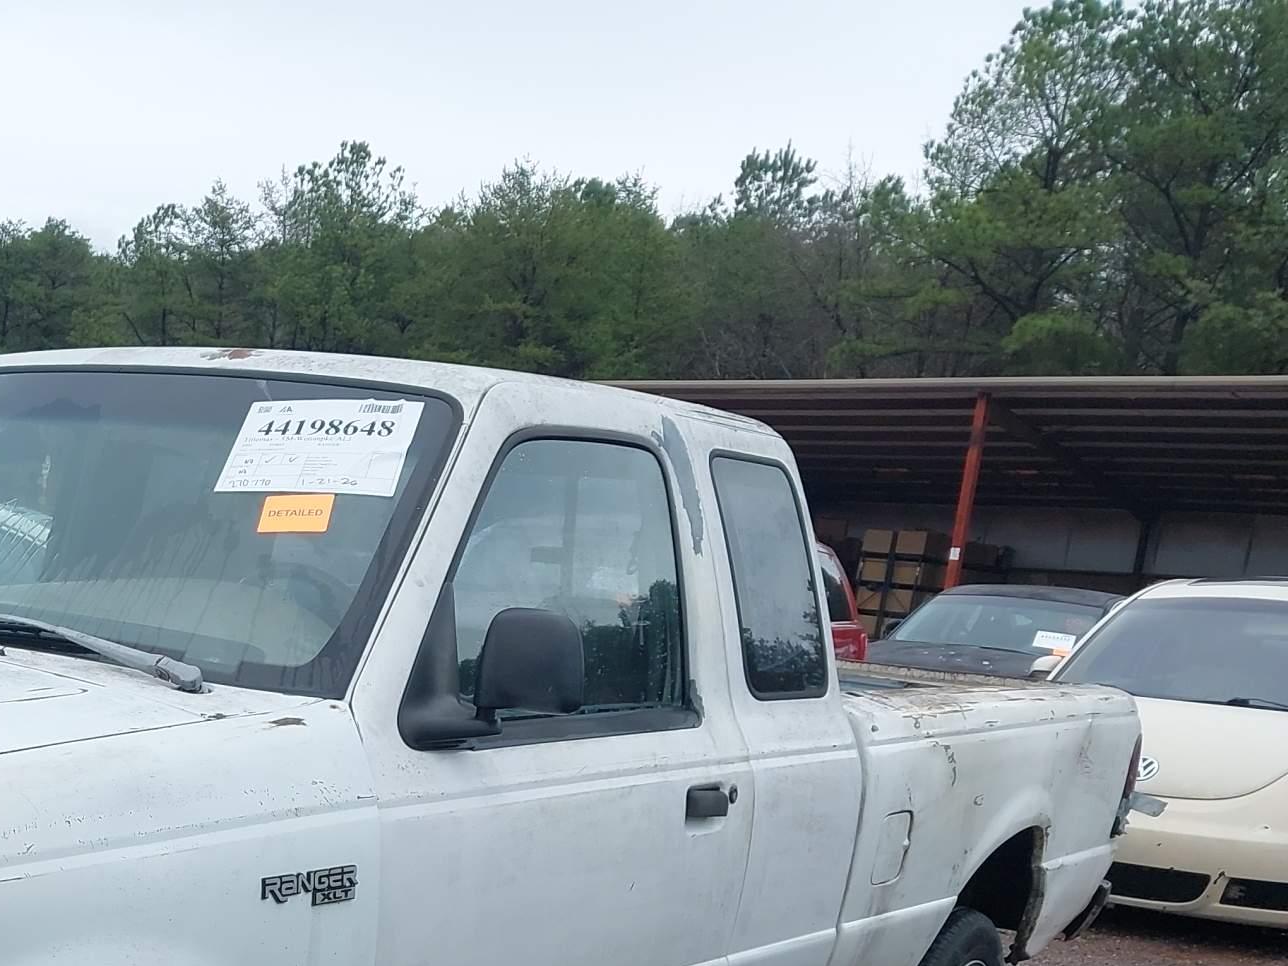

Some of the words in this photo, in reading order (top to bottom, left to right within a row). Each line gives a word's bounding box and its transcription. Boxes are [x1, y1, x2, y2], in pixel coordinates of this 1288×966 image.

[257, 419, 396, 437] 44198648
[268, 509, 324, 517] DETAILED
[261, 864, 358, 904] RANGER
[320, 888, 352, 903] XLT
